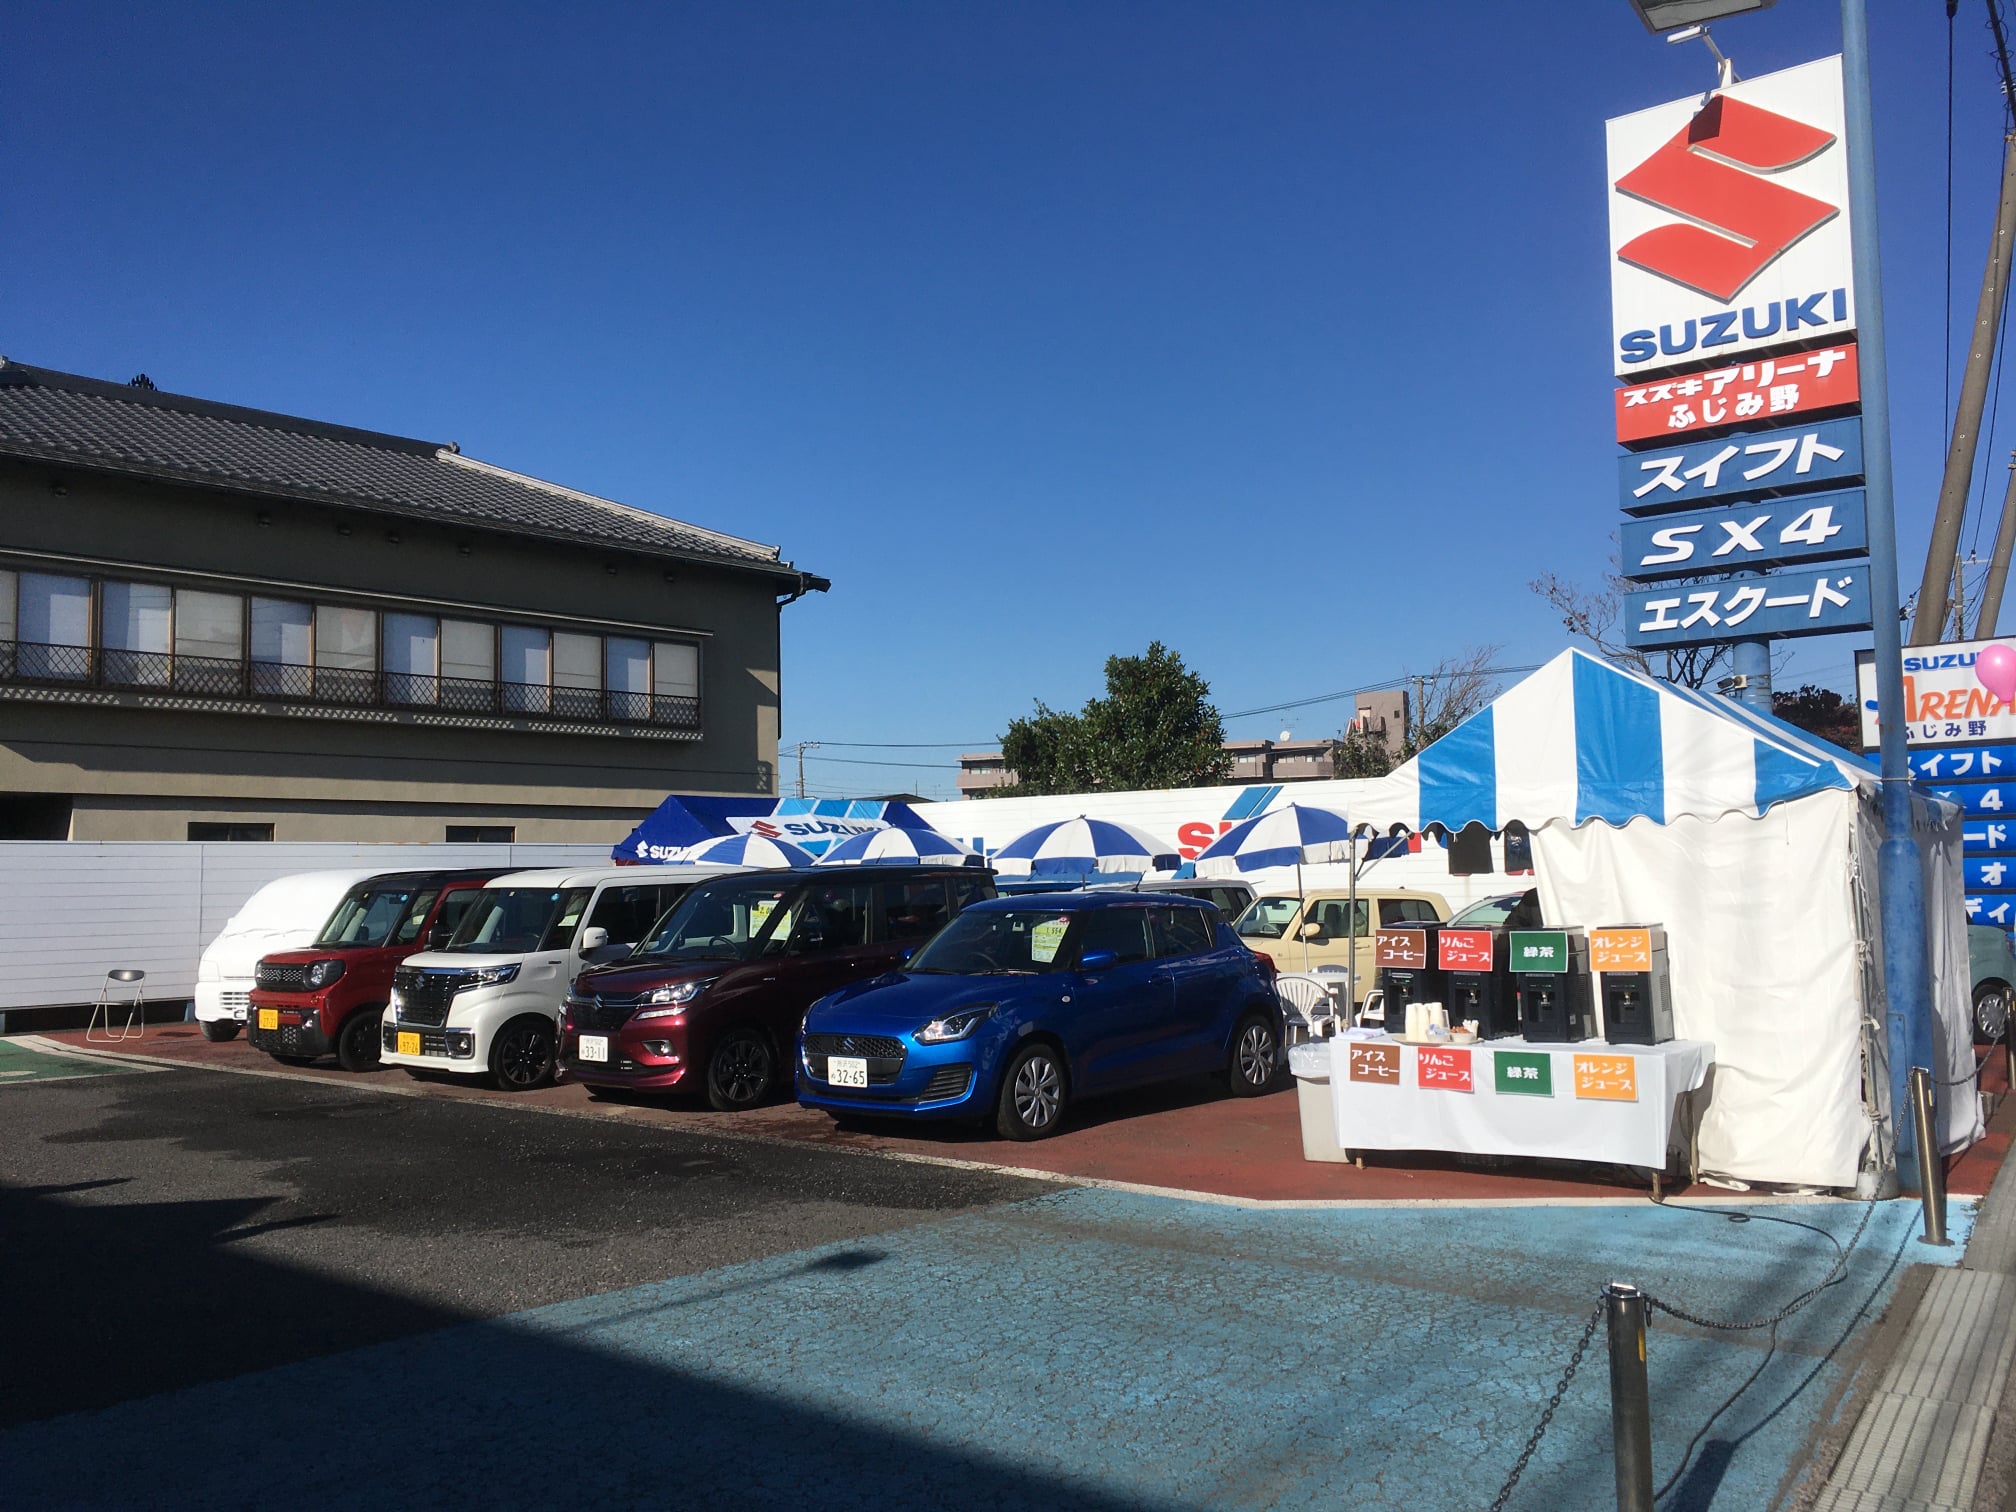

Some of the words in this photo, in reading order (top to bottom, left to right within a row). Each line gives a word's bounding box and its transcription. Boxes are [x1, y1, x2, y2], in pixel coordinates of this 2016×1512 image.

[1619, 287, 1848, 364] SUZUKI
[1624, 349, 1847, 408] スズキアリーナ
[1667, 383, 1800, 429] ふじみ野
[1632, 433, 1845, 499] スイフト
[1640, 505, 1843, 566] SX4
[1638, 576, 1853, 633] エスクード
[1904, 652, 1981, 671] SUZU
[1377, 936, 1411, 947] アイス
[1440, 937, 1475, 948] りんご
[1592, 936, 1643, 949] オレンジ
[1383, 949, 1424, 960] コーヒー
[1447, 950, 1490, 963] ジュース
[1523, 946, 1555, 958] 緑茶
[1597, 951, 1647, 963] ジュース
[1351, 1049, 1386, 1062] アイス
[1419, 1053, 1454, 1066] りんご
[1358, 1064, 1400, 1076] コーヒー
[1425, 1067, 1471, 1082] ジュース
[1506, 1066, 1539, 1079] 緑茶
[1576, 1061, 1628, 1075] オレンジ
[836, 1069, 865, 1085] 32-65
[1581, 1077, 1632, 1090] ジュース
